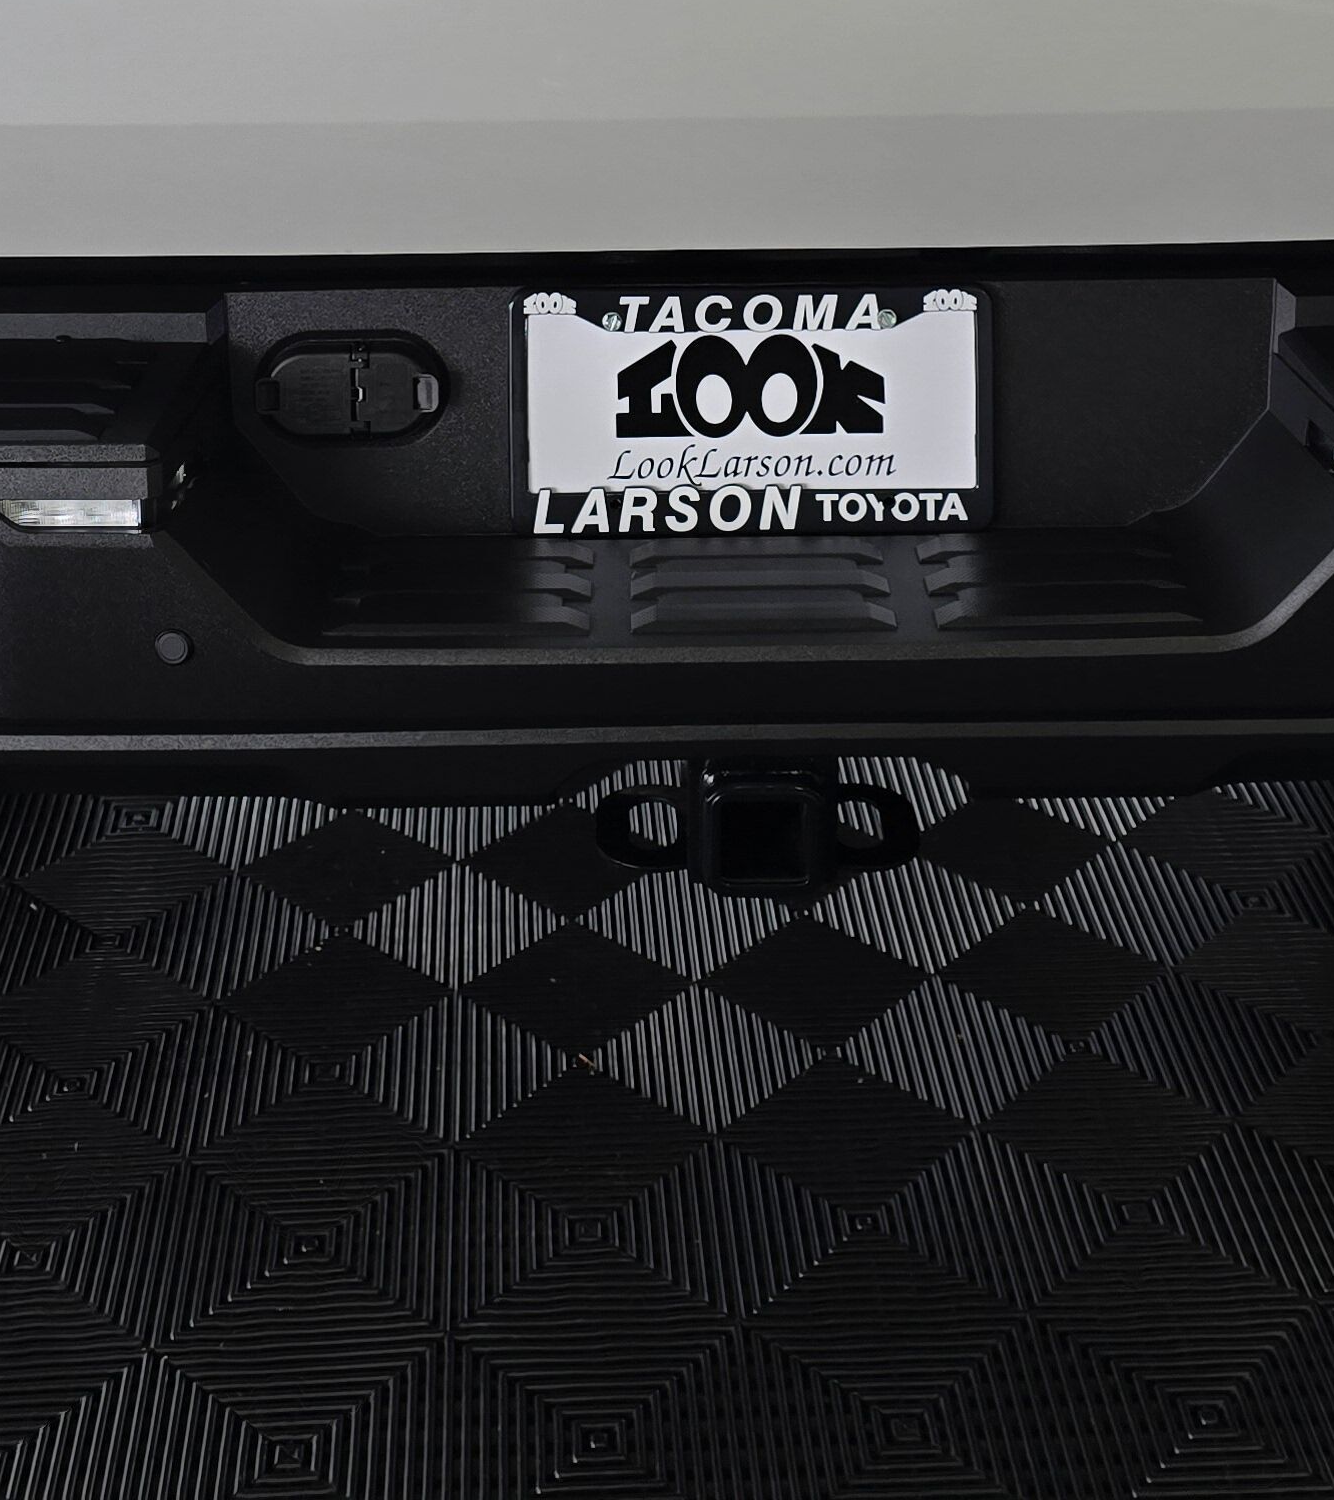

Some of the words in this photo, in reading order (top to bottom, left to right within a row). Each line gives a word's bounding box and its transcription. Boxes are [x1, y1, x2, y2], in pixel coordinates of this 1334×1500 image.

[618, 293, 881, 333] TACOMA
[615, 334, 886, 439] LOOK
[607, 443, 897, 486] LookLarson.com
[533, 484, 803, 534] LARSON
[815, 492, 969, 523] TOYOTA
